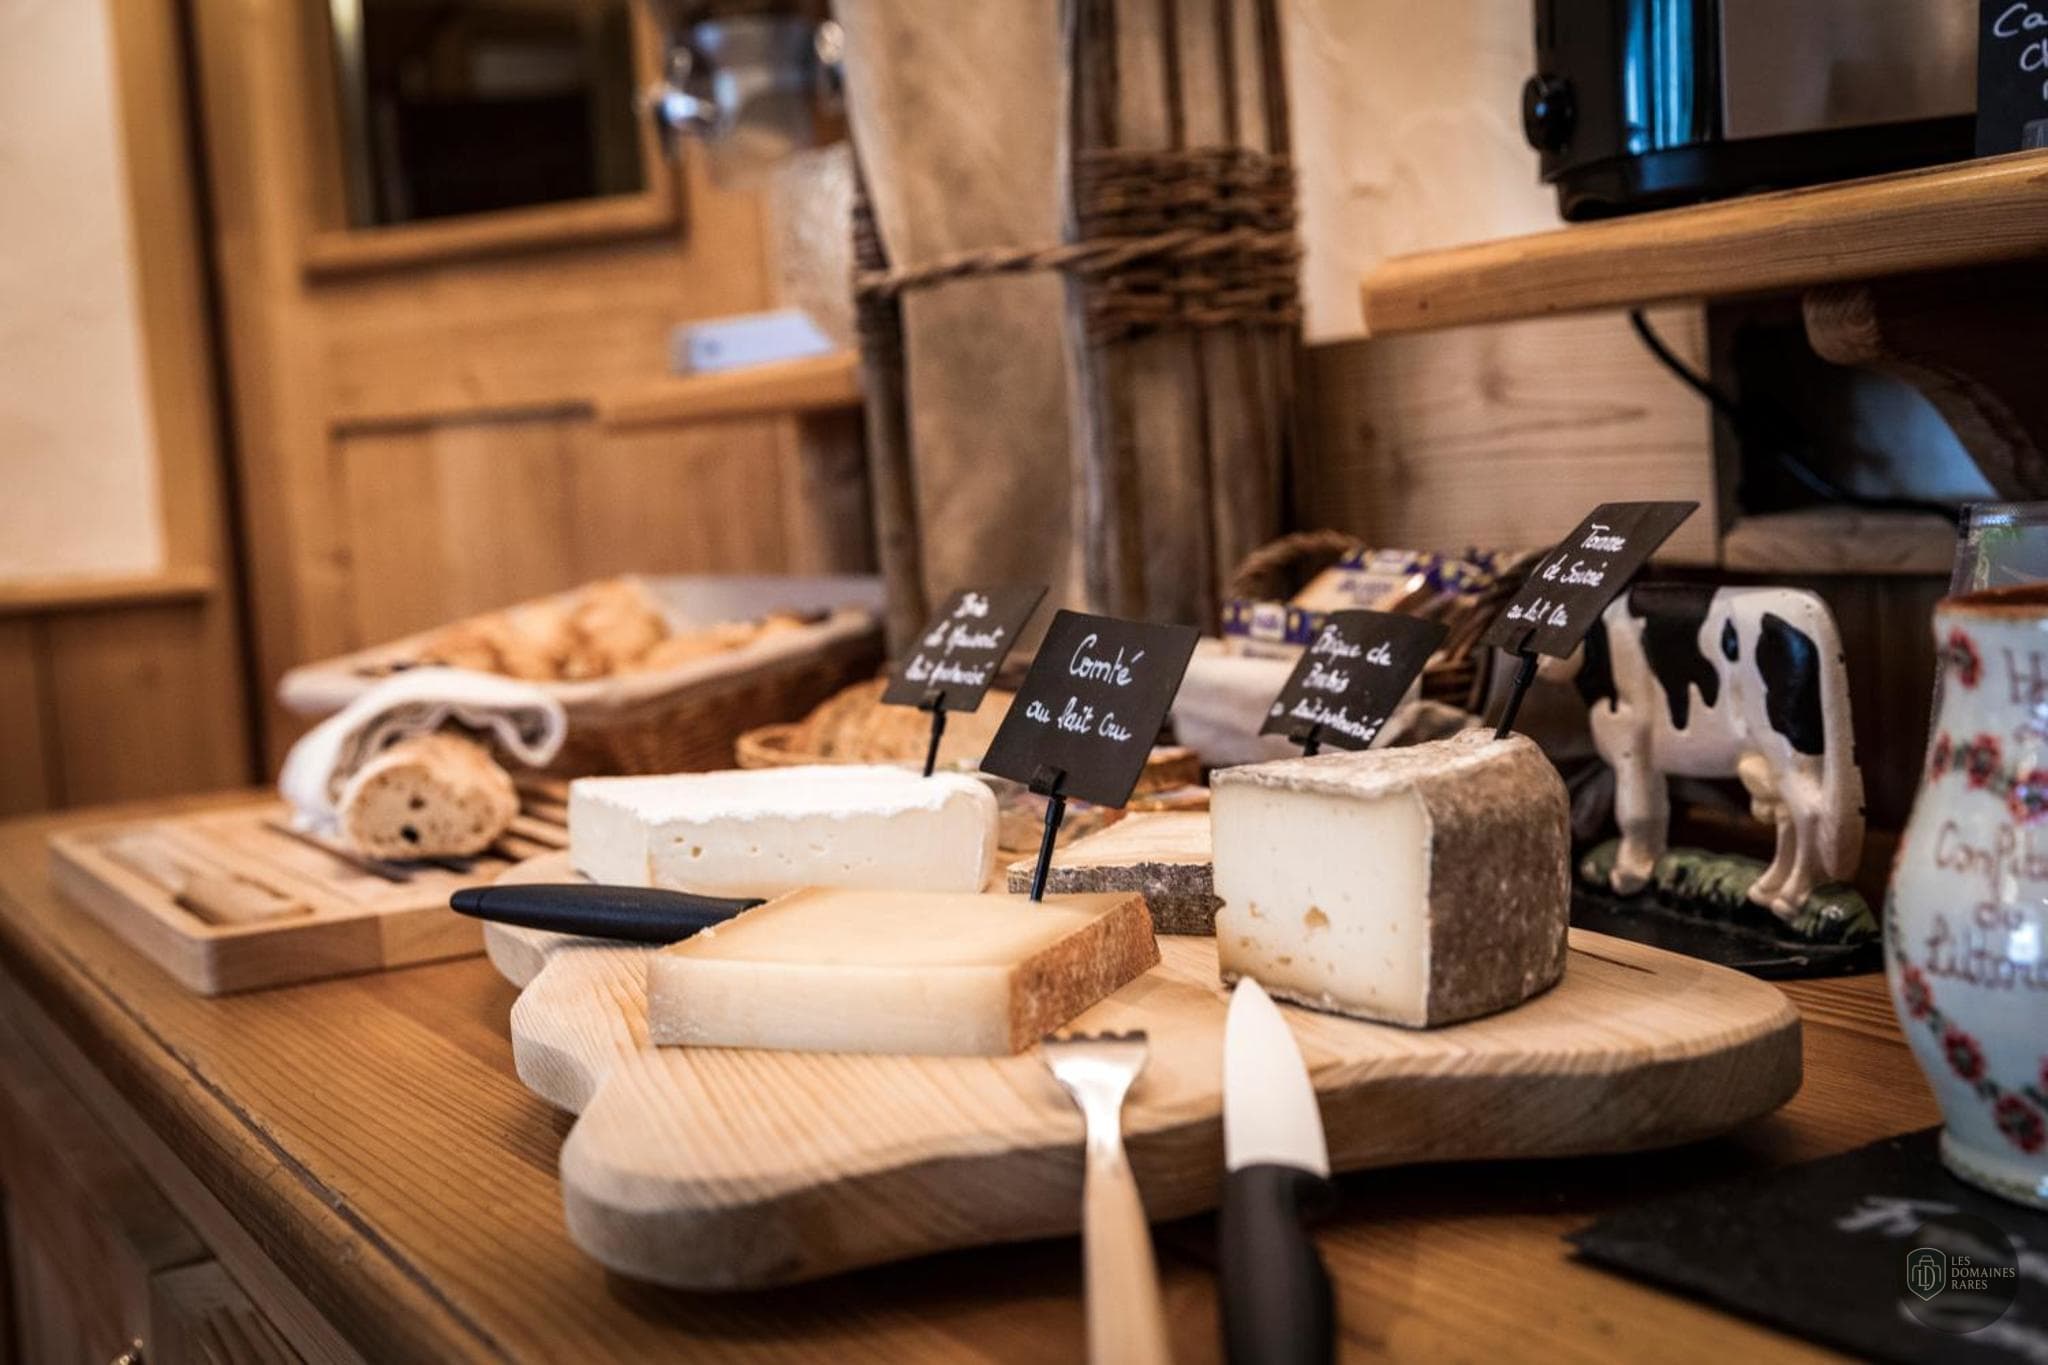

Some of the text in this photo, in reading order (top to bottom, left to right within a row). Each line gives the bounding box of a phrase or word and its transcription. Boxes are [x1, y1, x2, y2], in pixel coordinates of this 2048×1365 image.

[1069, 632, 1144, 686] Comté
[1366, 641, 1391, 666] de
[1026, 700, 1050, 723] au
[1057, 696, 1094, 734] lait
